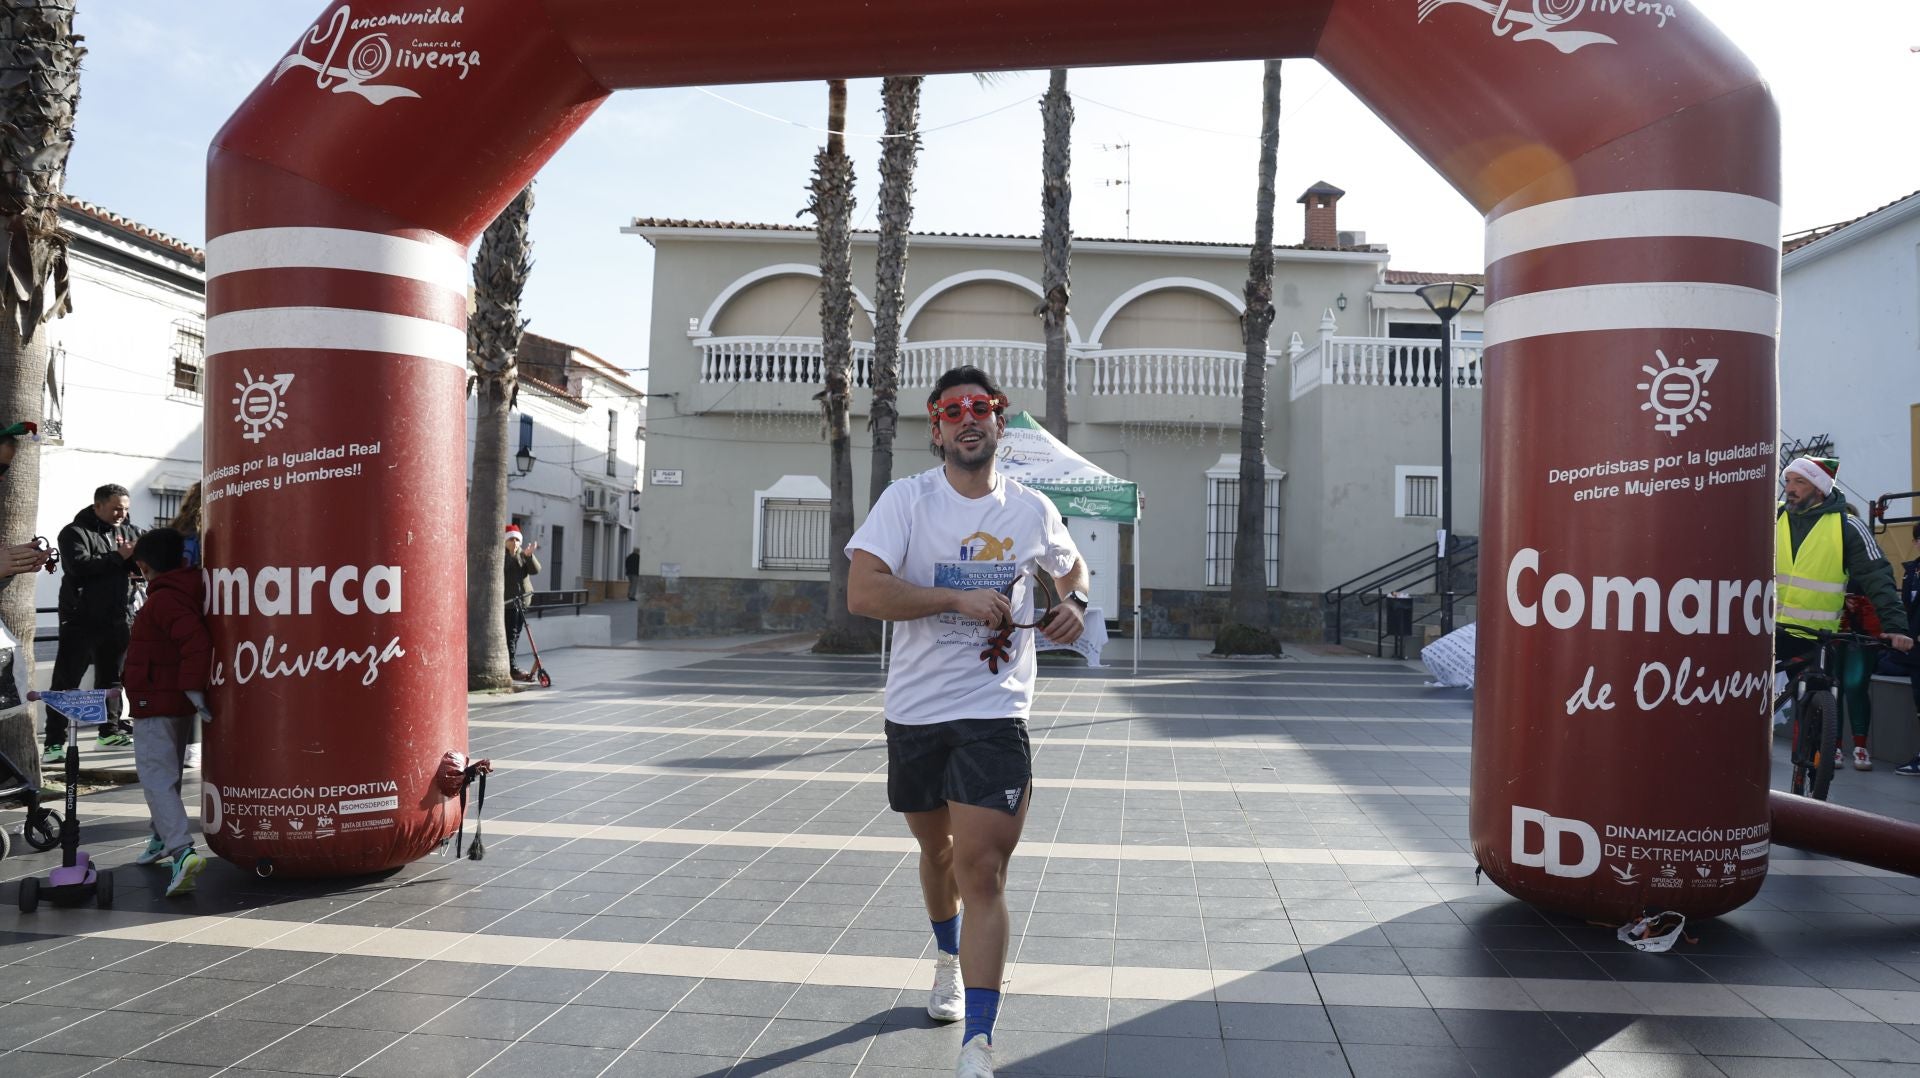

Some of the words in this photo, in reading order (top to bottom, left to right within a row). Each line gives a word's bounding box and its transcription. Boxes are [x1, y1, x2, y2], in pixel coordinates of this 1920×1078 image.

[411, 39, 448, 48] Comarca
[450, 40, 461, 48] de
[243, 459, 263, 476] por
[267, 455, 279, 467] la
[282, 445, 345, 468] Igualdad
[349, 441, 381, 456] Real
[1549, 458, 1649, 484] Deportistas
[1654, 454, 1682, 473] por
[1687, 450, 1700, 464] la
[1705, 442, 1757, 466] Igualdad
[226, 478, 270, 497] Mujeres
[273, 476, 282, 490] y
[285, 463, 362, 485] Hombres!!
[1085, 484, 1124, 492] OLIVENZA
[1574, 484, 1620, 501] entre
[1624, 476, 1690, 496] Mujeres
[1695, 474, 1704, 491] y
[1708, 464, 1766, 486] Hombres!!
[203, 564, 402, 617] omarca
[233, 635, 406, 686] Olivenza
[1566, 665, 1616, 716] de
[222, 784, 315, 800] DINAMIZACIÓN
[319, 781, 399, 798] DEPORTIVA
[223, 802, 236, 815] DE
[238, 803, 338, 817] EXTREMADURA
[1511, 805, 1601, 879] DD
[1605, 825, 1723, 843] DINAMIZACIÓN
[1604, 843, 1626, 858] DE
[1631, 848, 1740, 862] EXTREMADURA
